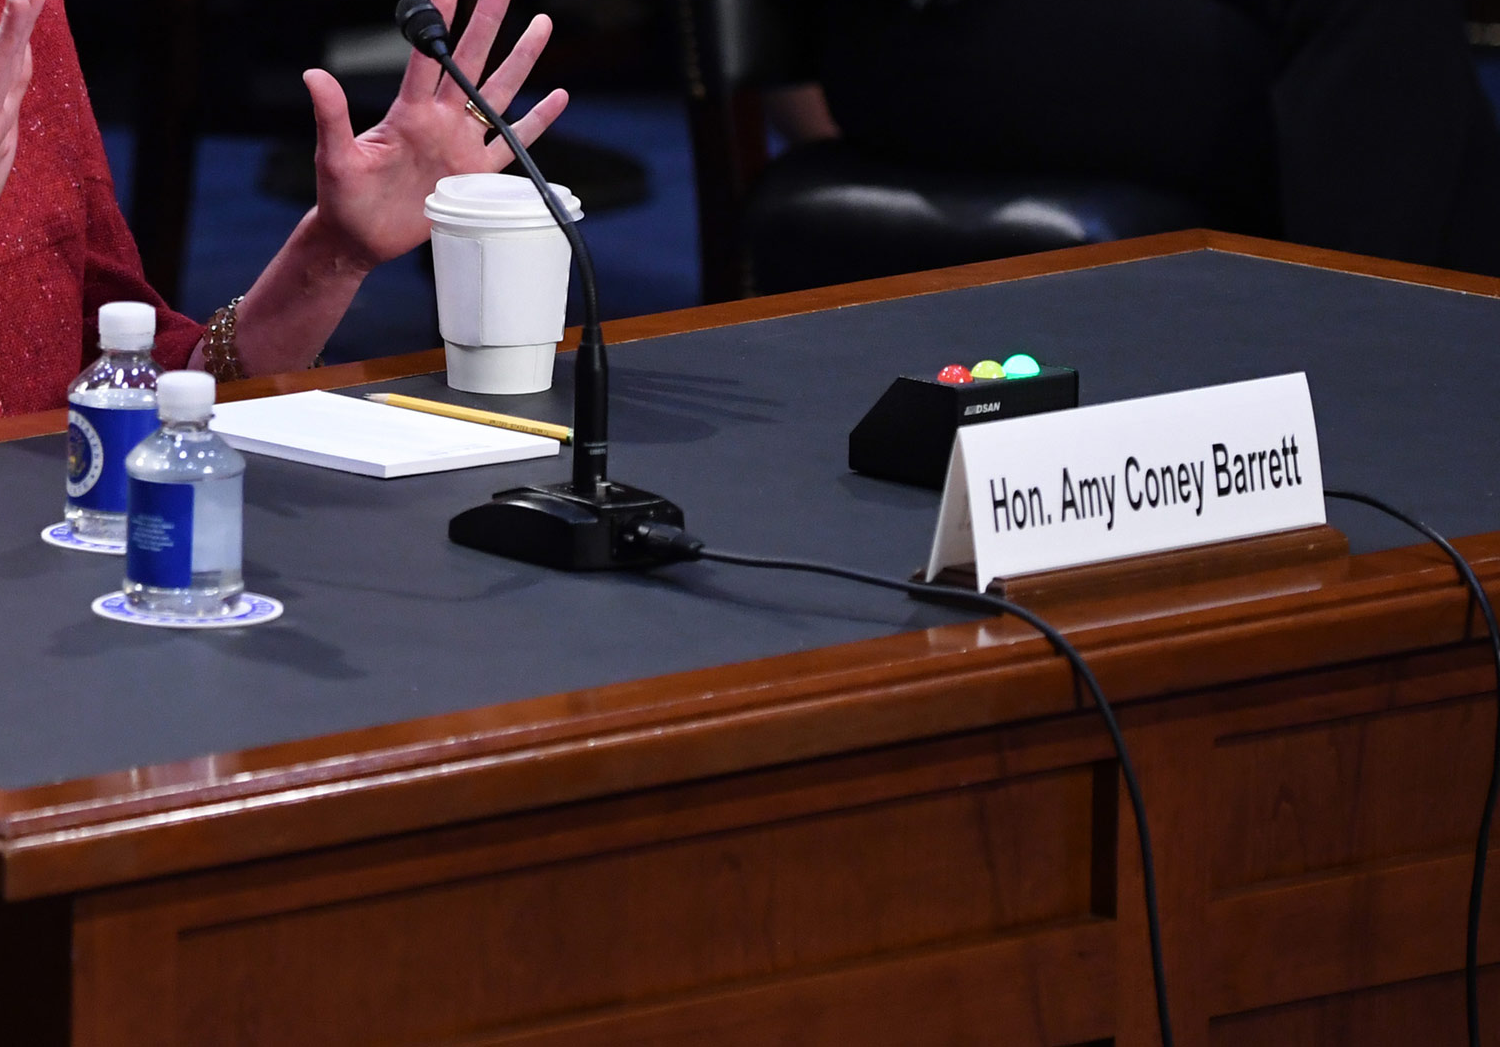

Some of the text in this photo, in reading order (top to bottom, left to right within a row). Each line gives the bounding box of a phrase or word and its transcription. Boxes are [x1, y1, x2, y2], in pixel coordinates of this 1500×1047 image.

[990, 433, 1303, 534] Hon. Amy Coney Barrett
